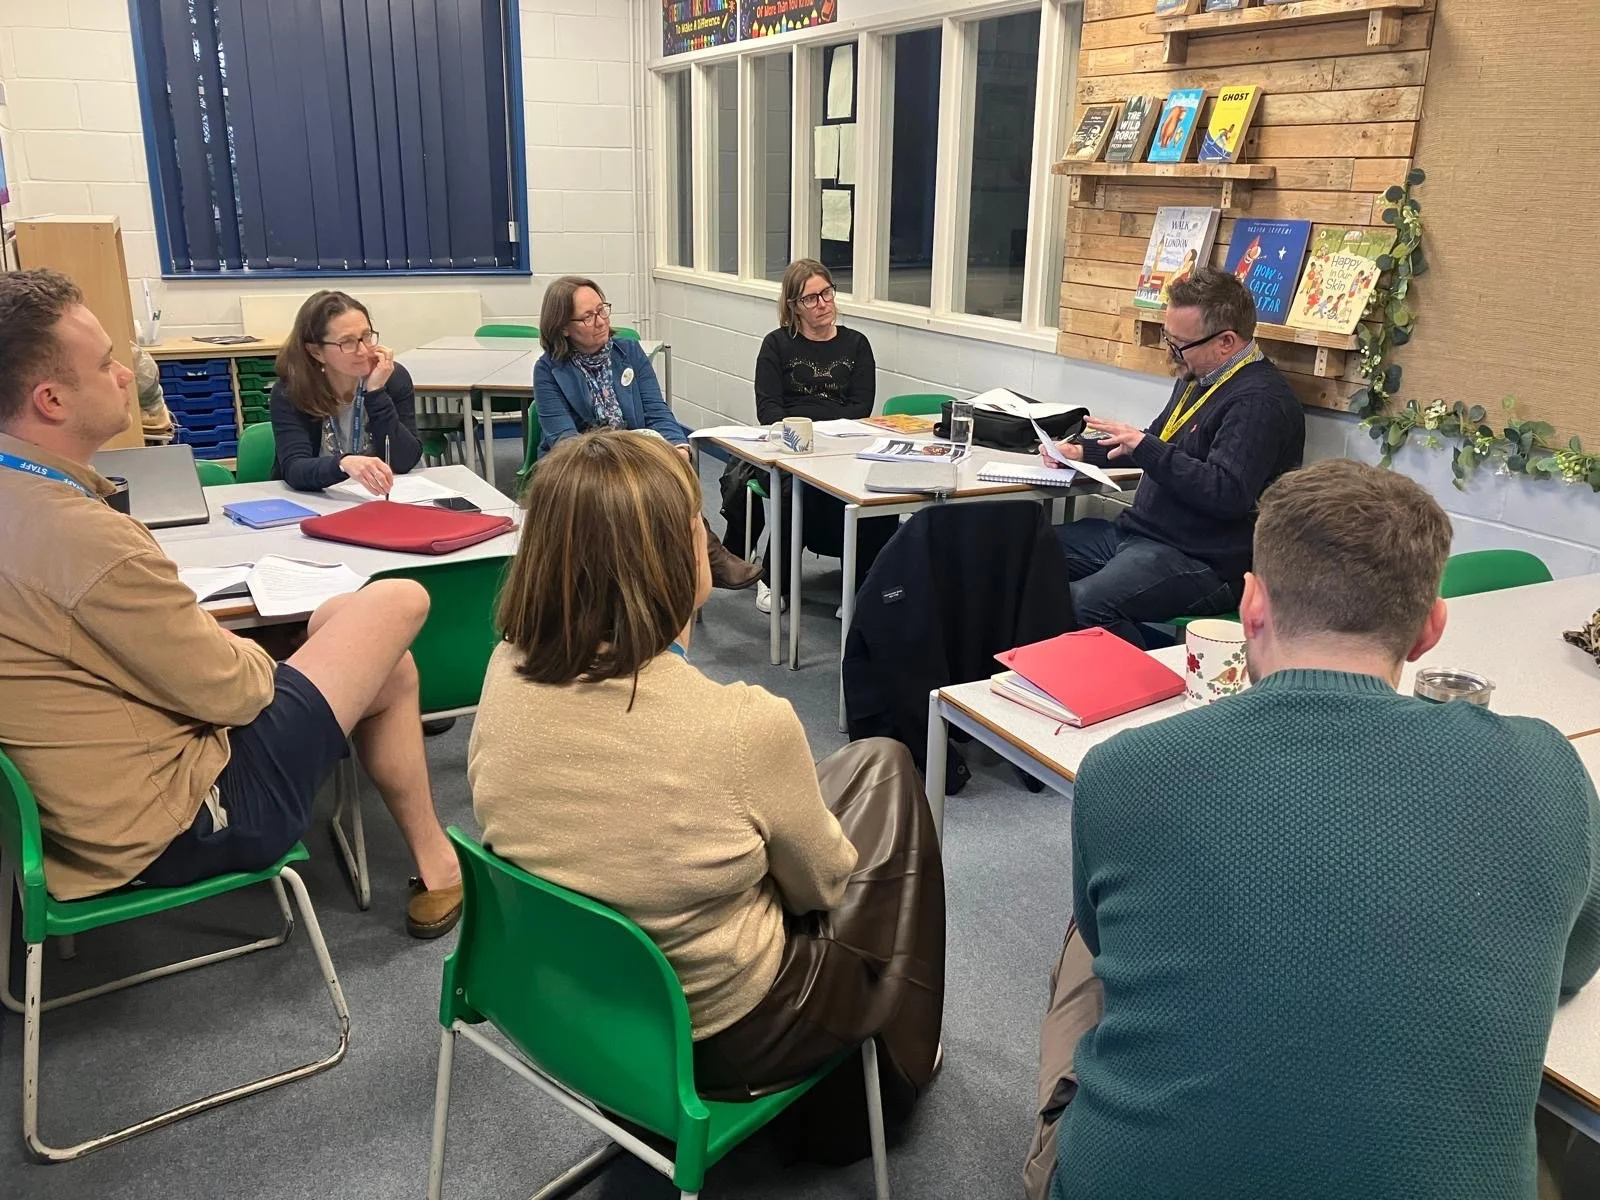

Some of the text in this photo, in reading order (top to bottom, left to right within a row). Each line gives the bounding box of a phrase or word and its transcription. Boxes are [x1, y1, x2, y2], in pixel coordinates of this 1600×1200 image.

[1222, 92, 1250, 102] GHOST
[1127, 111, 1142, 120] THE
[1120, 120, 1141, 130] WILD
[1113, 130, 1140, 141] ROBOT
[1171, 220, 1190, 230] WALK
[1164, 238, 1189, 248] LONDON
[1331, 255, 1362, 270] Happy
[1253, 264, 1277, 280] HOW
[1339, 269, 1352, 279] Our
[1249, 278, 1280, 297] CATCH
[1325, 278, 1346, 291] Skin
[1256, 296, 1281, 313] STAR
[19, 461, 48, 475] STAFF
